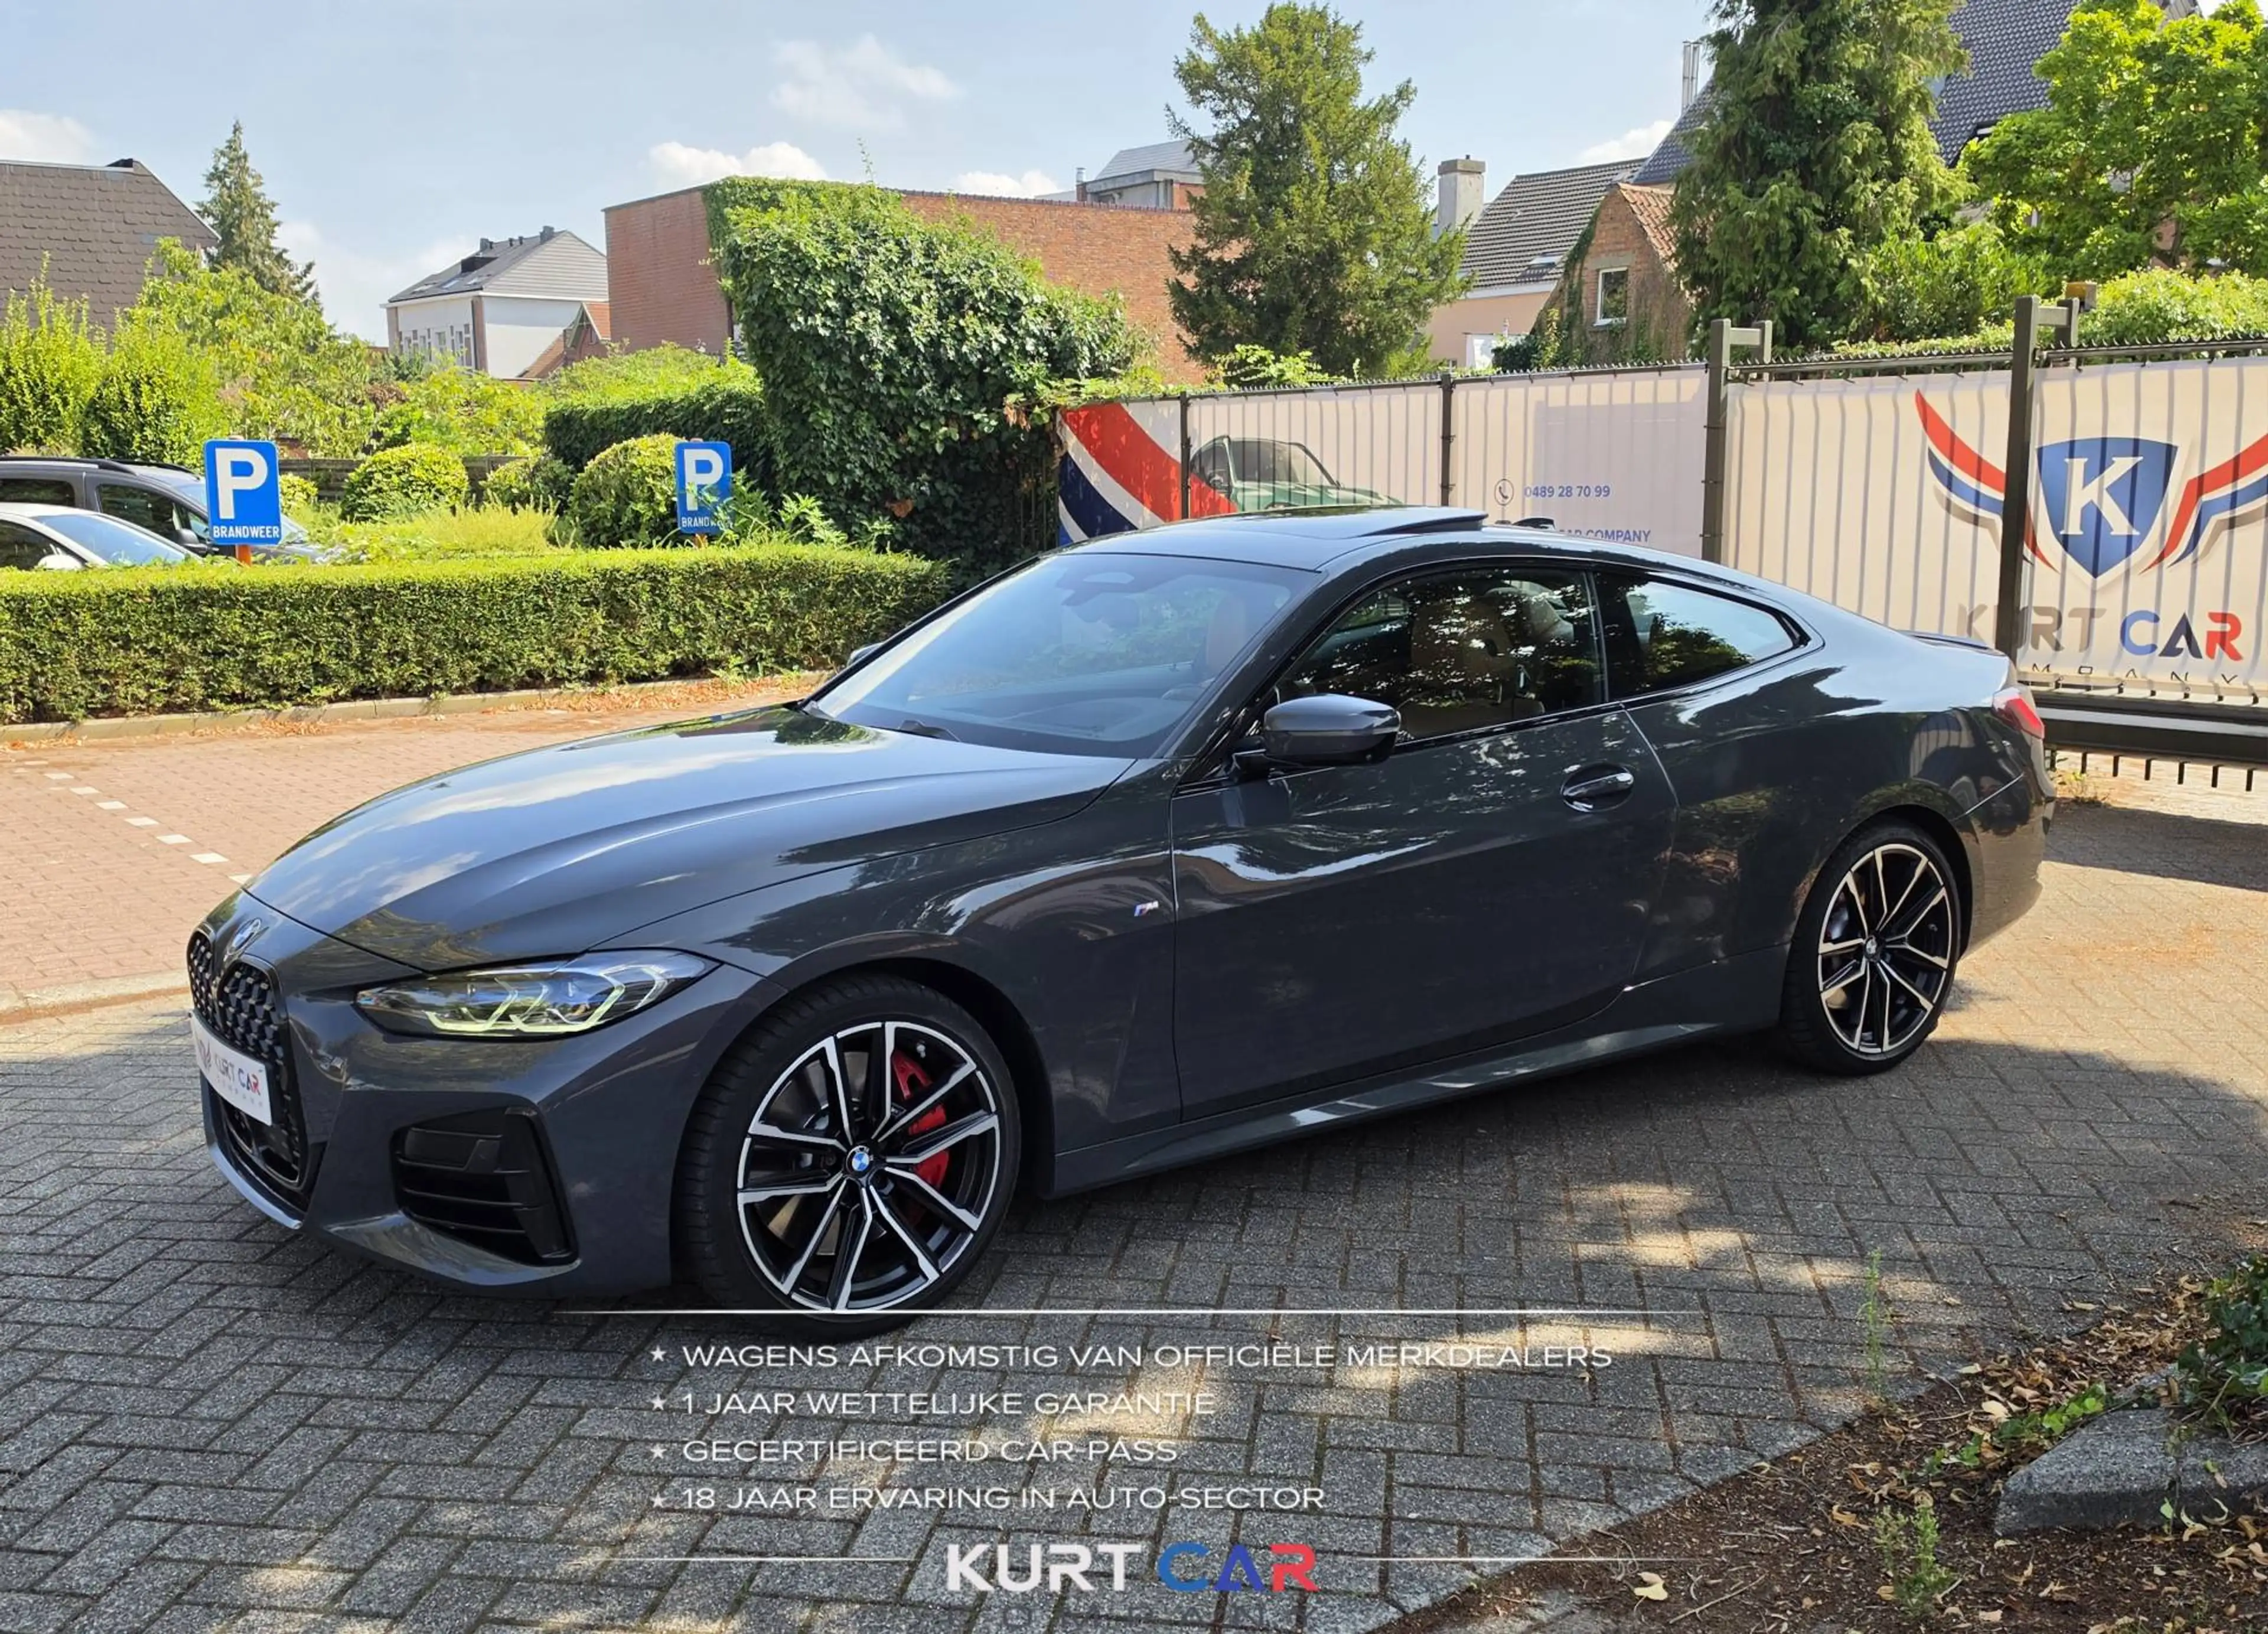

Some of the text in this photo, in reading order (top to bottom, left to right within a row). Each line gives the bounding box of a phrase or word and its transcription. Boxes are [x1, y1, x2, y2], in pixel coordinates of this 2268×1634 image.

[215, 448, 268, 519] P
[684, 449, 724, 511] P
[1524, 486, 1610, 497] 0489 28 70 99
[2060, 457, 2143, 535] K
[213, 525, 279, 538] BRANDWEER
[682, 516, 733, 529] BRAND
[2120, 610, 2243, 661] CAR
